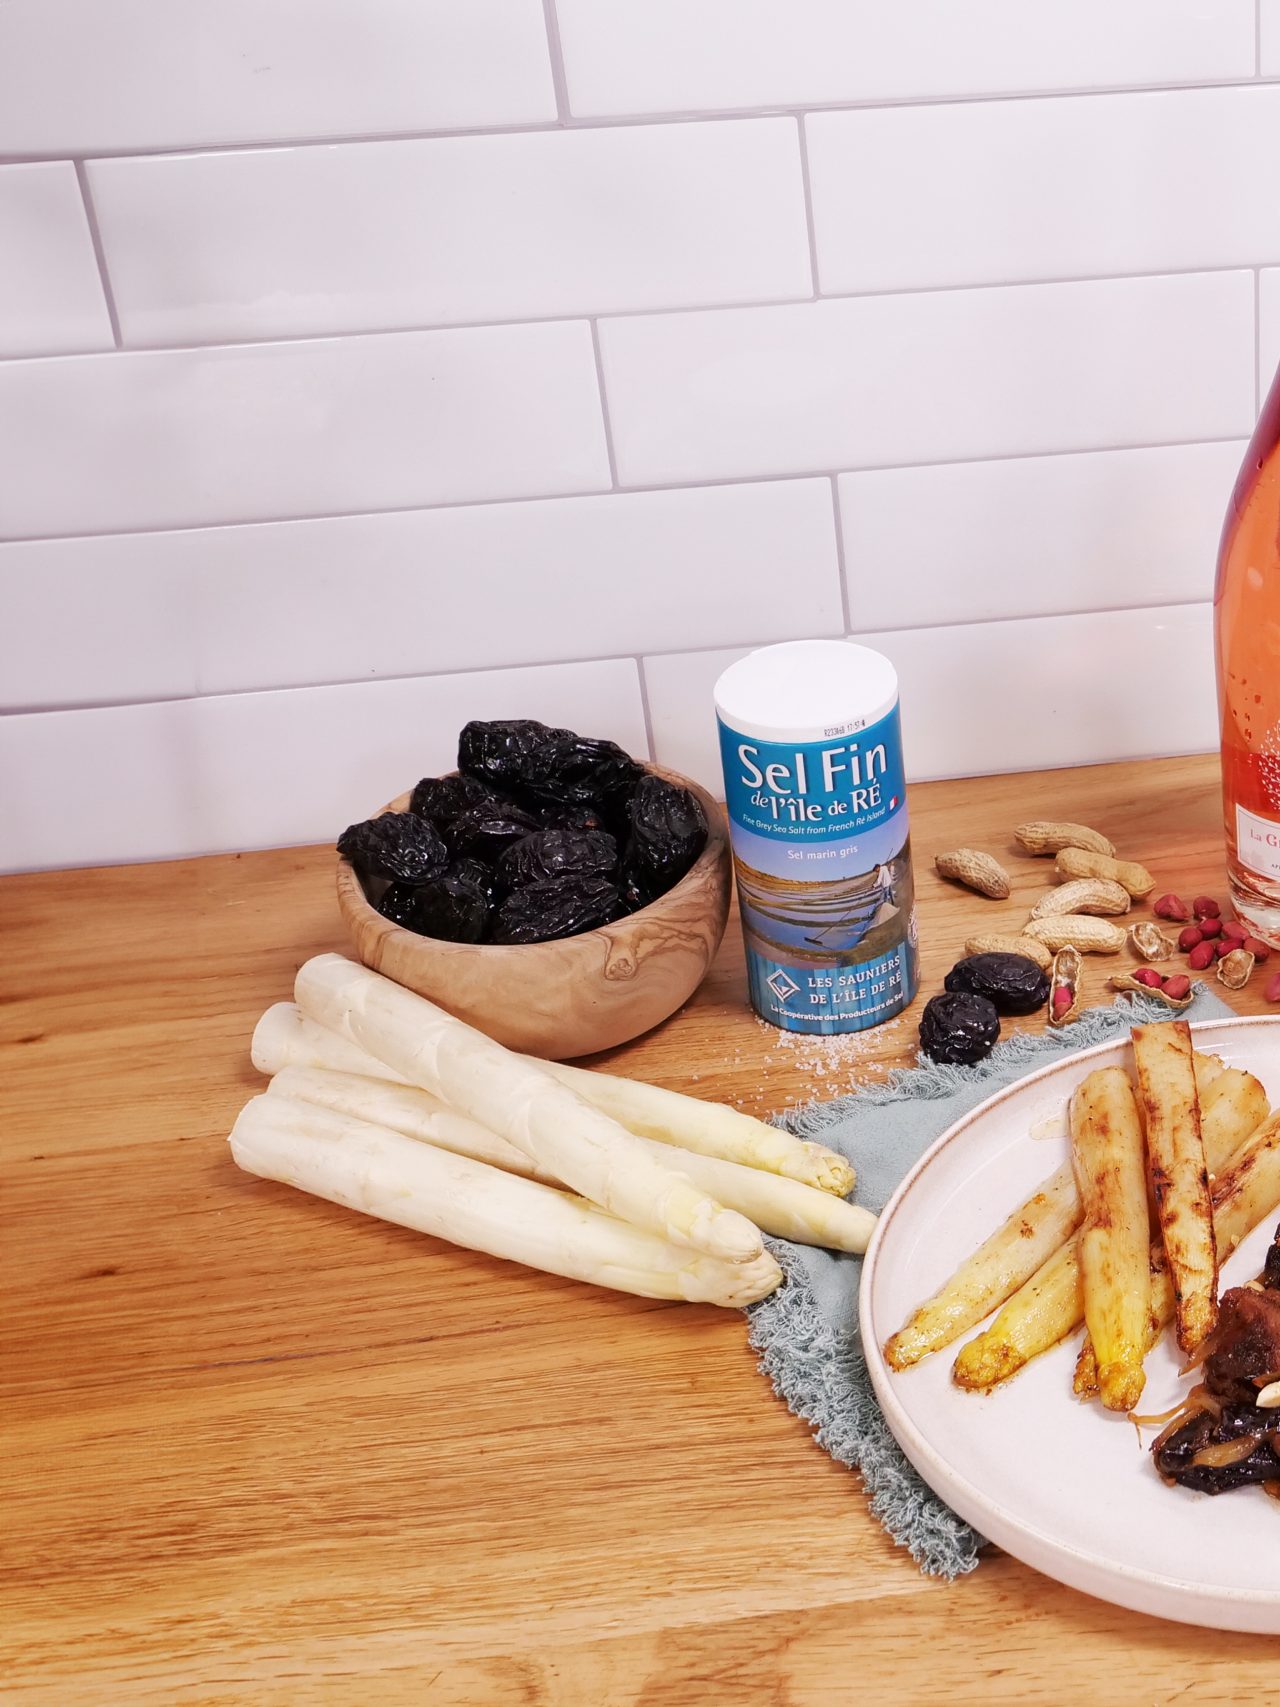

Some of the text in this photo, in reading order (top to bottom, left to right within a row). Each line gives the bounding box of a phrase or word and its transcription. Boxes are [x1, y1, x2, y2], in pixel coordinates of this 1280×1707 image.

[737, 743, 887, 795] Sel Fin
[751, 791, 768, 808] de
[828, 800, 847, 816] de
[850, 777, 882, 814] RÉ
[743, 807, 886, 835] Fine Grey Sea Salt from French Ré Island
[1250, 828, 1262, 842] La
[787, 844, 859, 860] Sel marin gris
[808, 955, 900, 988] LES SAUNIERS
[809, 994, 827, 1004] DE
[871, 984, 886, 995] DE
[888, 971, 902, 987] RÉ
[770, 1004, 779, 1012] La
[779, 1007, 823, 1021] Coopérative
[839, 1002, 886, 1019] Producteurs
[885, 997, 895, 1006] de
